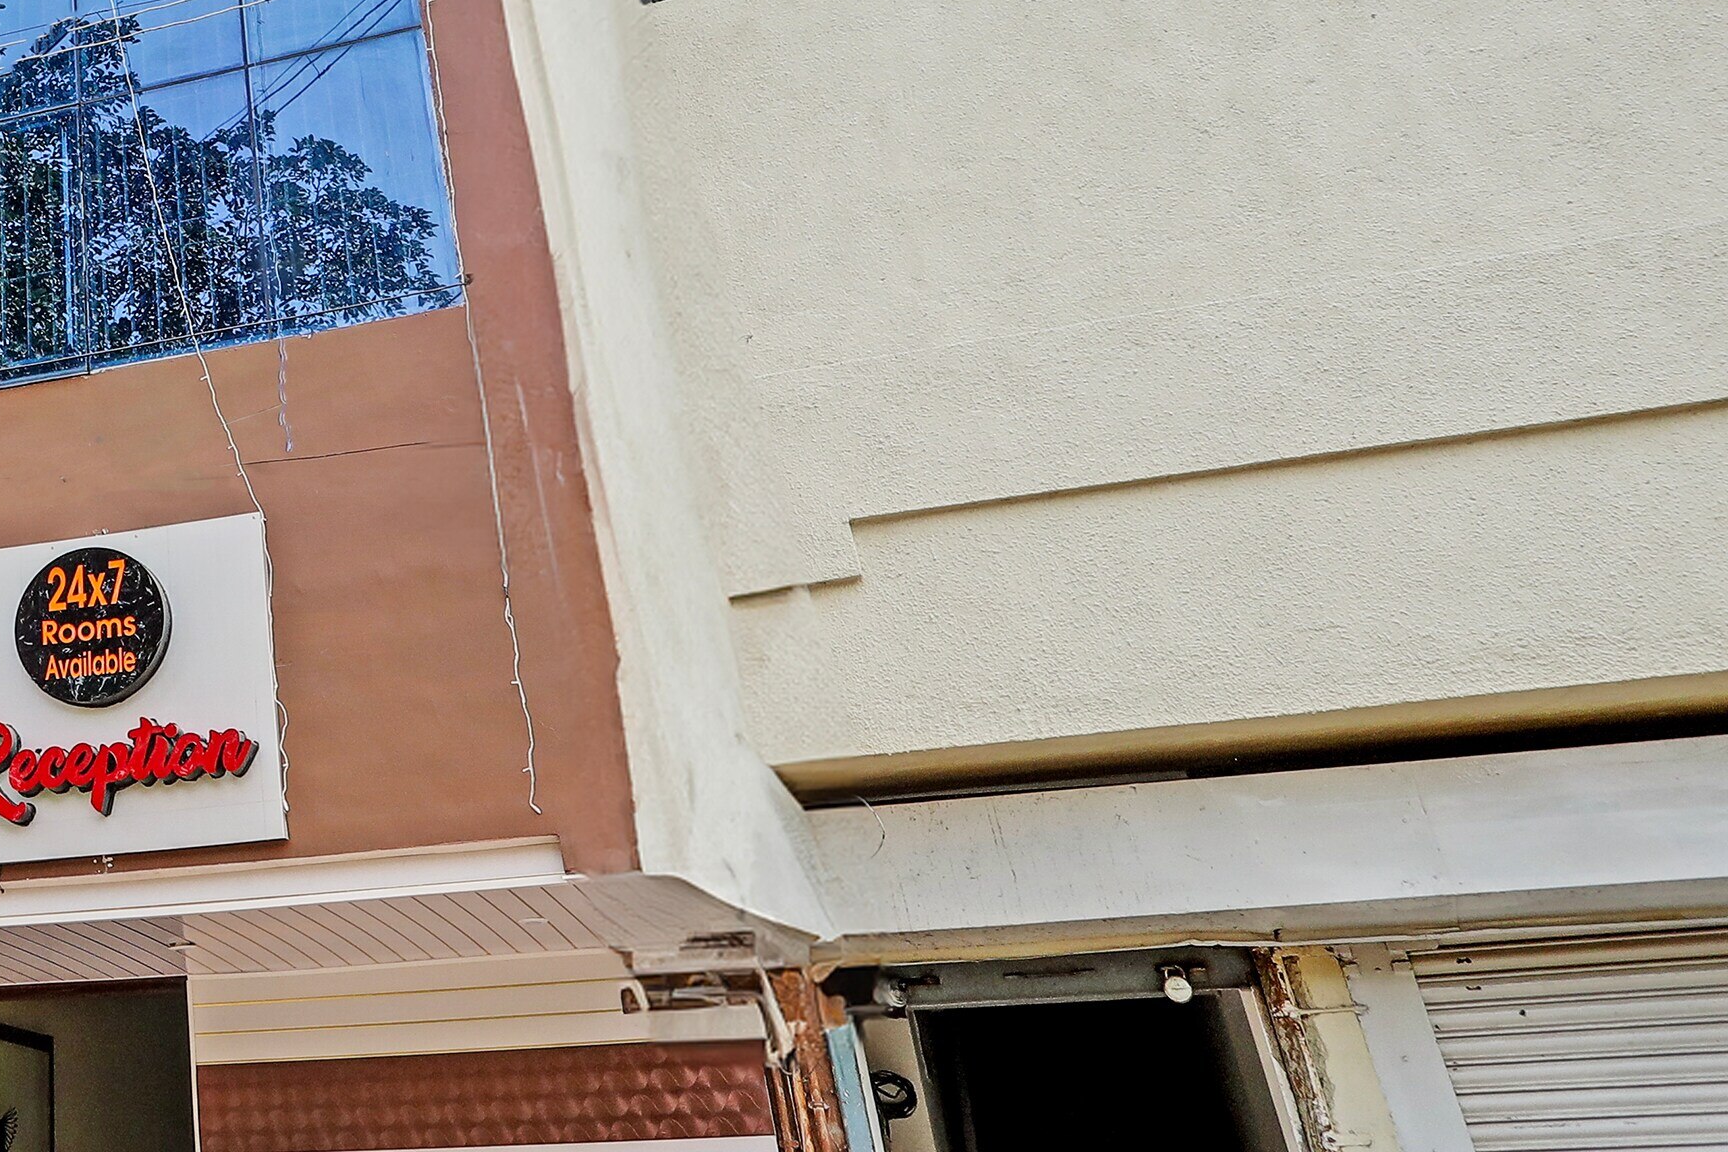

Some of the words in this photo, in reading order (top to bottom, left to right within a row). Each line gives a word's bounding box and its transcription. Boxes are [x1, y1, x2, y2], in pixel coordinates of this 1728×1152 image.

[47, 559, 125, 612] 24x7
[41, 615, 137, 645] Rooms
[45, 648, 137, 680] Available
